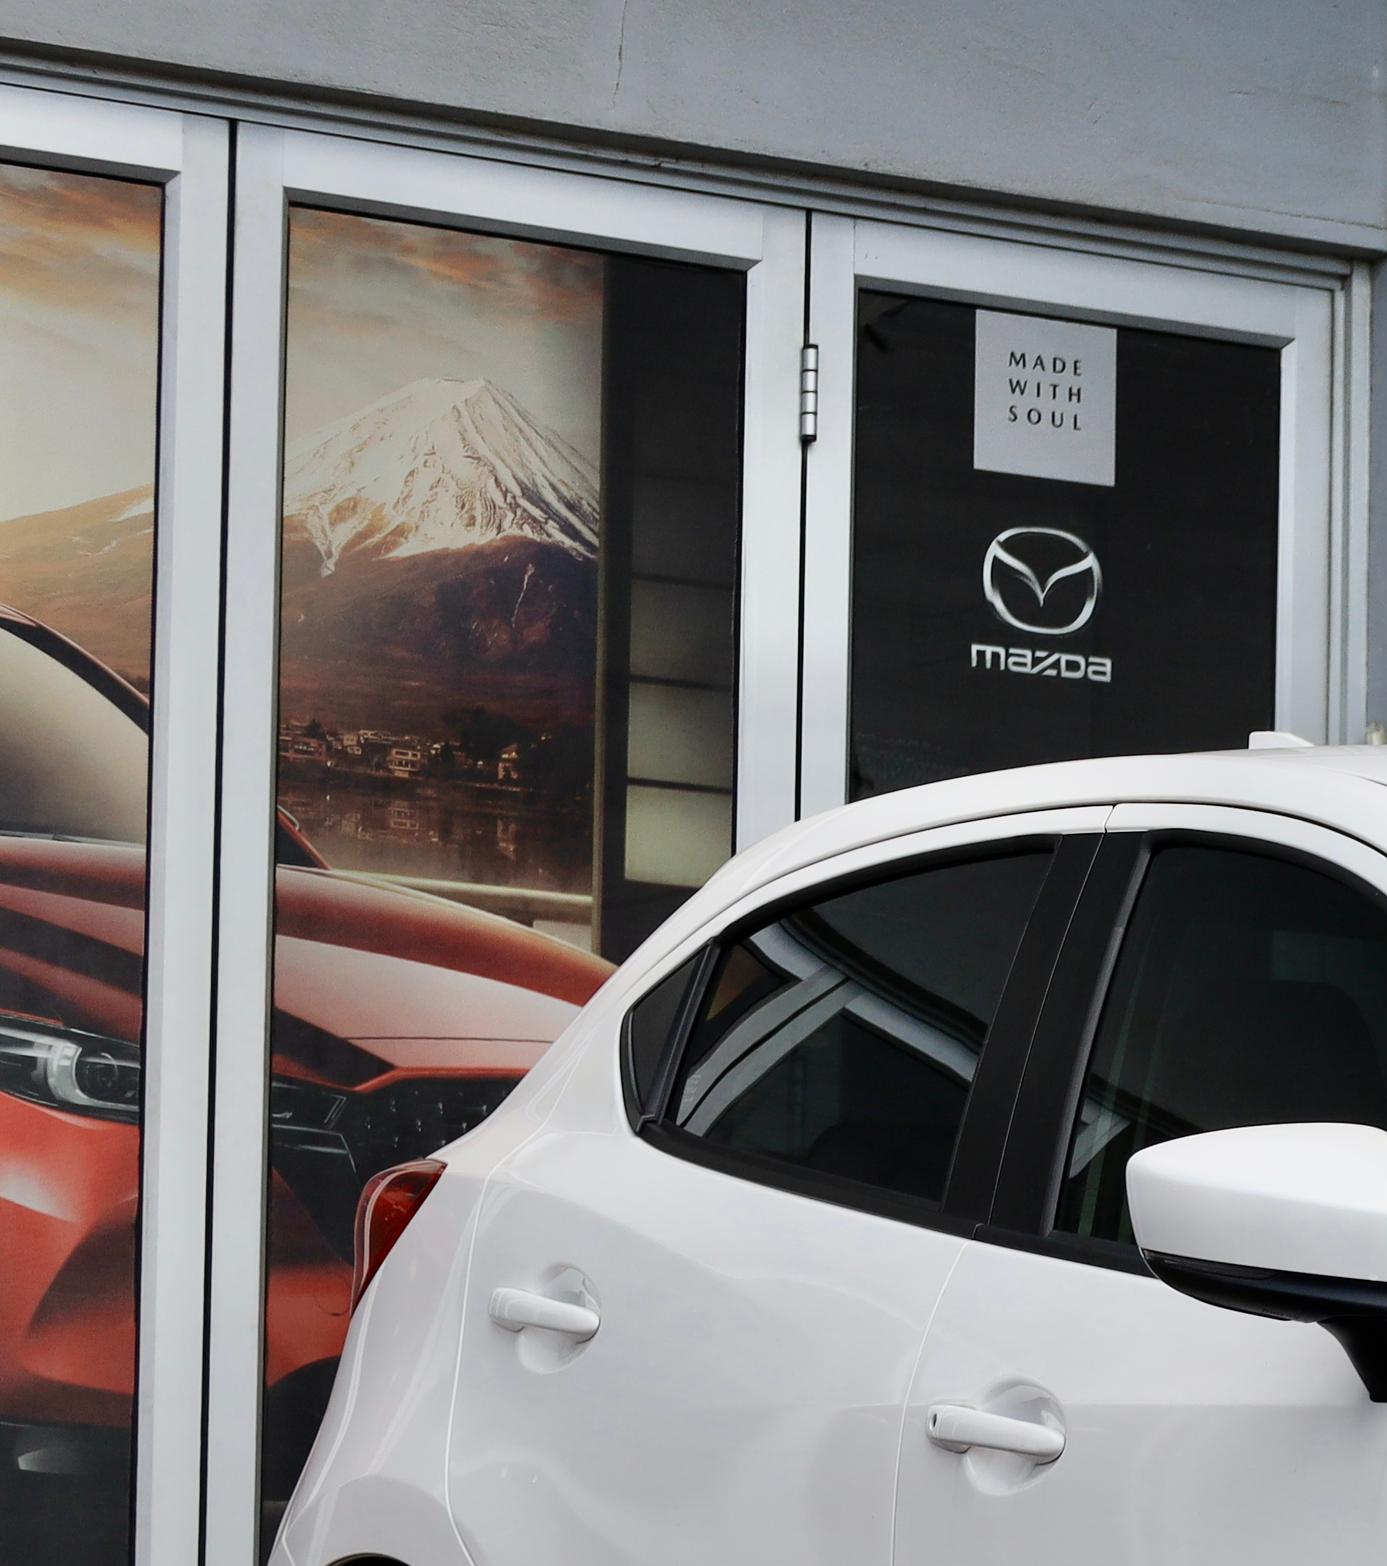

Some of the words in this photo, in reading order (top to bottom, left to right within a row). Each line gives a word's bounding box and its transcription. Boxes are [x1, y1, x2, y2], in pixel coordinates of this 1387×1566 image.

[1008, 351, 1083, 377] MADE
[1008, 378, 1083, 404] WITH
[1008, 405, 1082, 431] SOUL
[970, 643, 1112, 683] mazda
